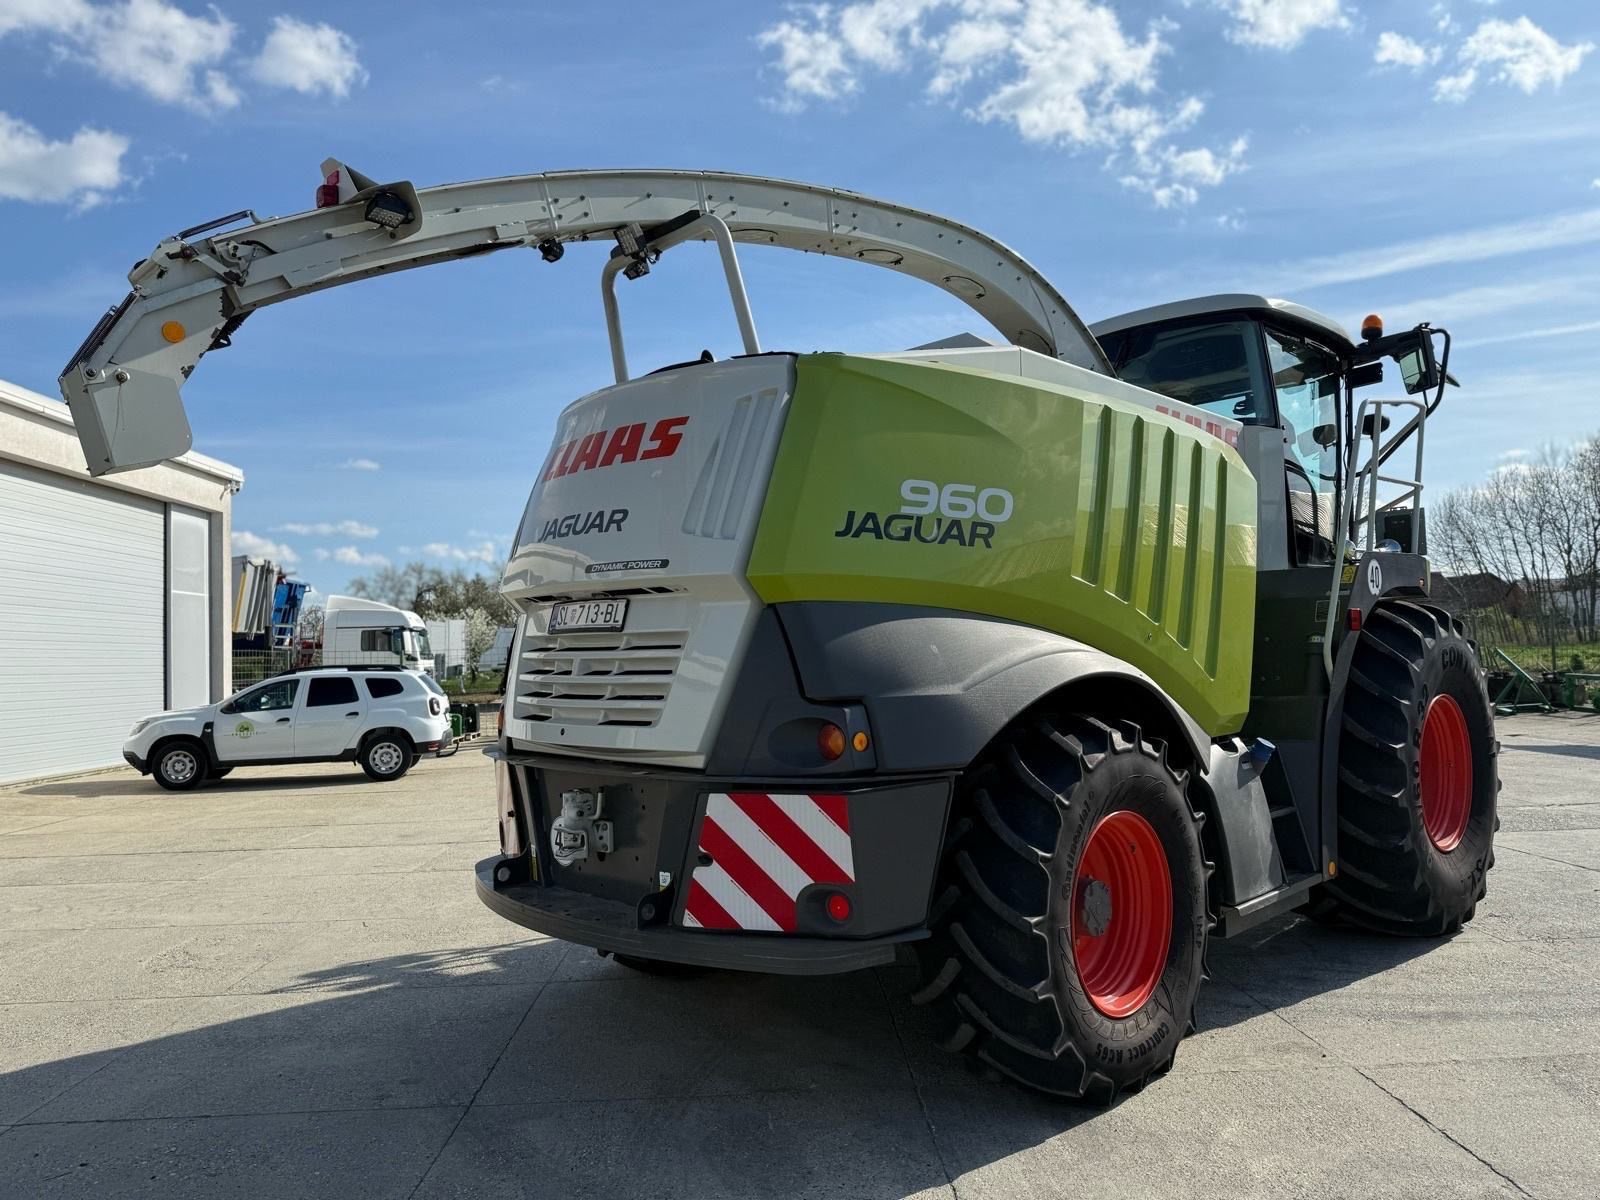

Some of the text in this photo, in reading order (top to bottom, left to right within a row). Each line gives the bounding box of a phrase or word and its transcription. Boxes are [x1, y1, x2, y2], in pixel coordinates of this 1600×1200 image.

[541, 415, 690, 482] CLAAS
[900, 479, 1014, 523] 960
[537, 508, 629, 543] JAGUAR
[834, 510, 996, 549] JAGUAR
[591, 560, 662, 572] DYNAMIC POWER
[1370, 565, 1380, 589] 40
[558, 606, 569, 625] SL
